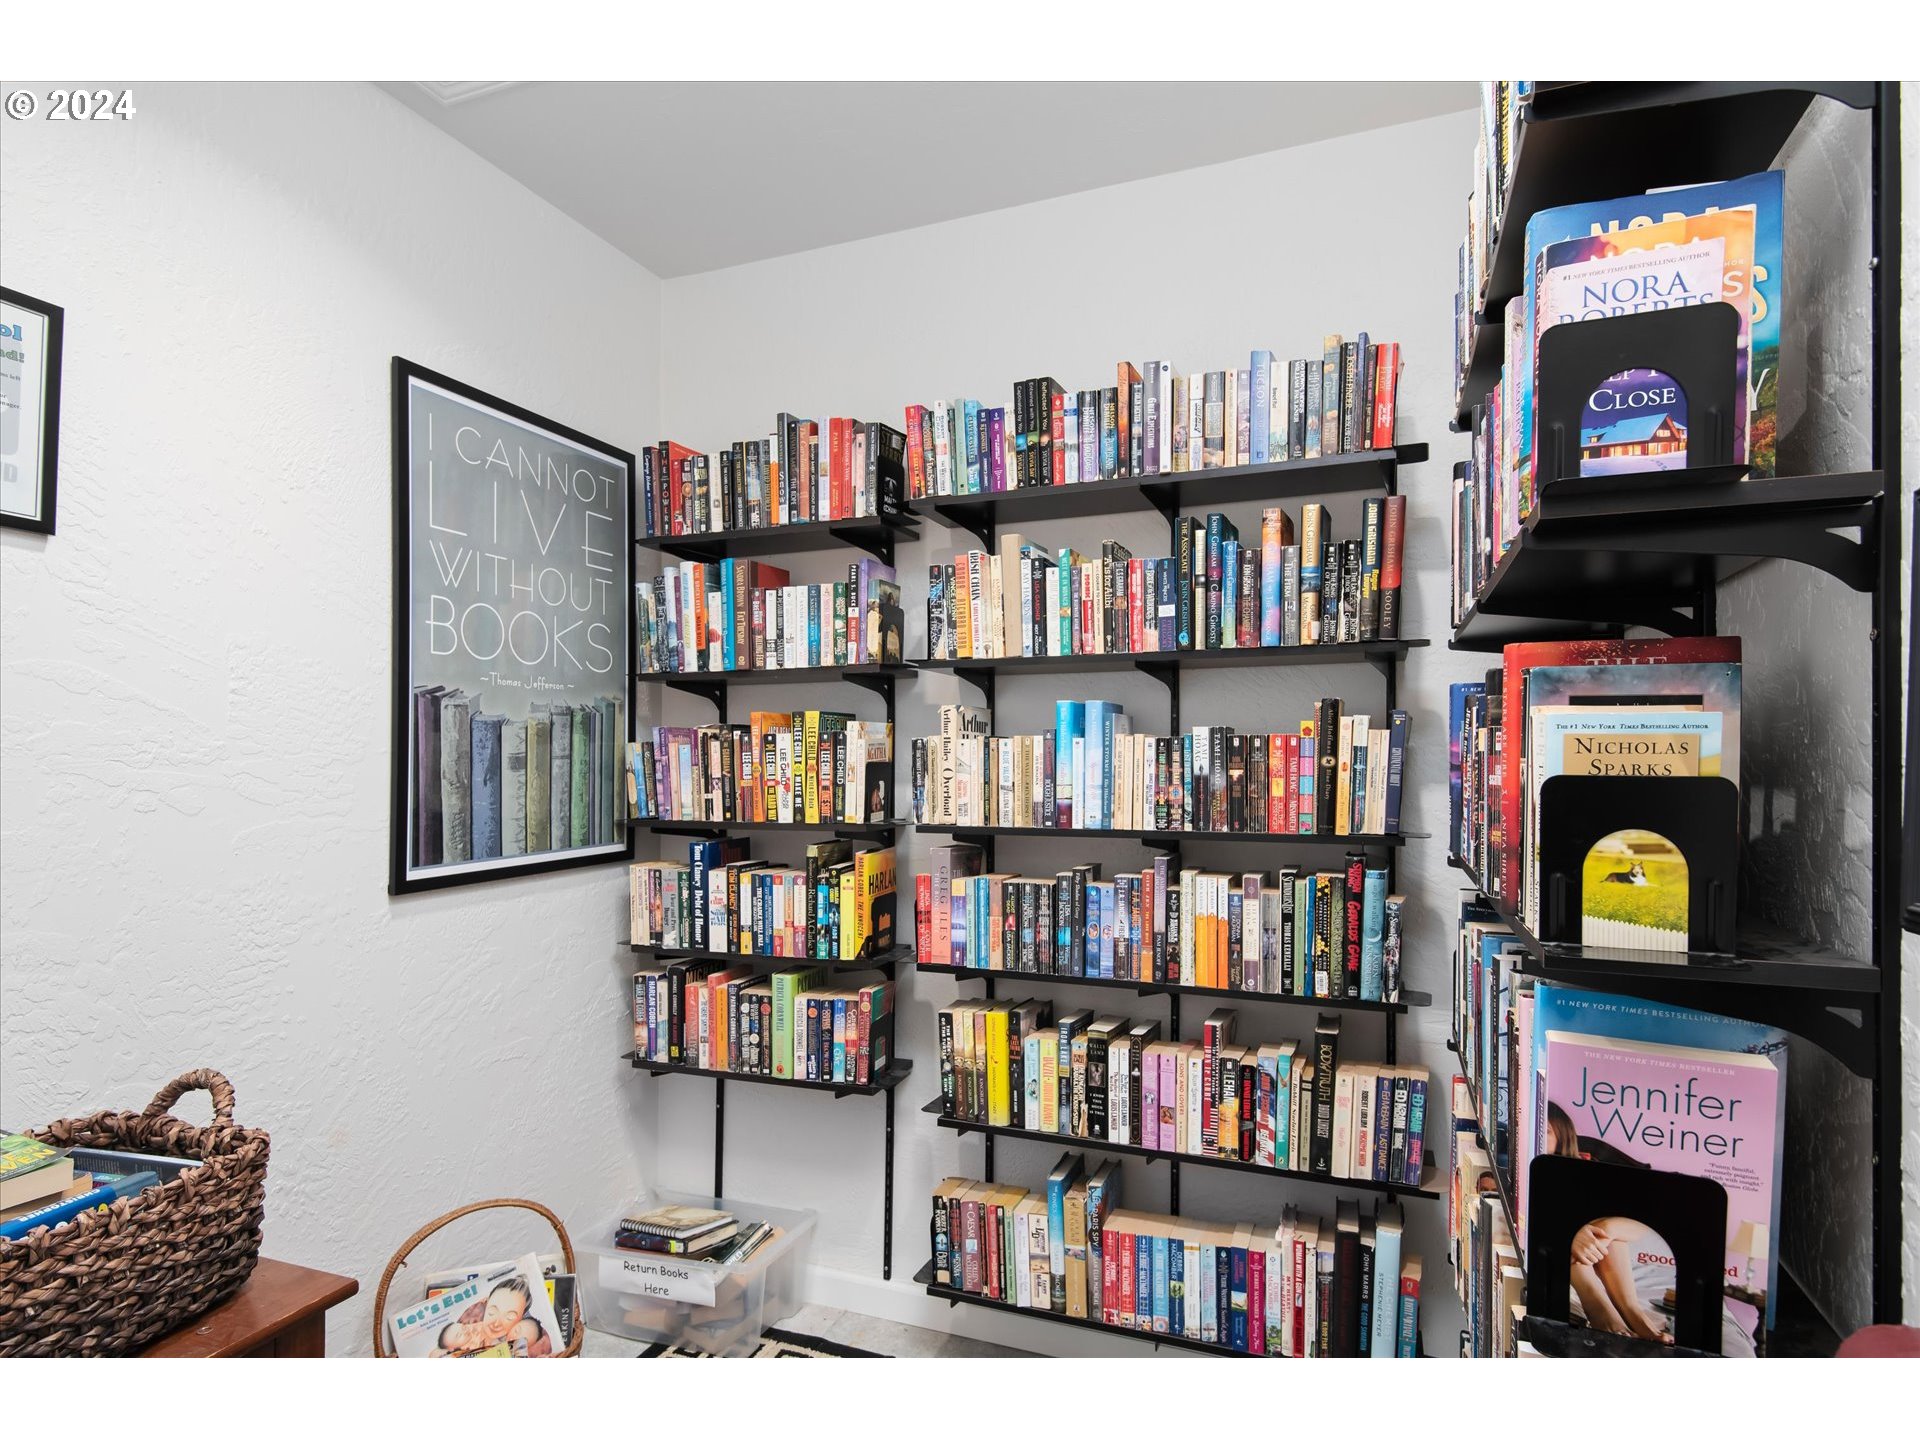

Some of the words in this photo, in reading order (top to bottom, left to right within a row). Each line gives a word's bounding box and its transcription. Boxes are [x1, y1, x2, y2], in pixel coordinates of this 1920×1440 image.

[1573, 272, 1587, 280] NEW
[1588, 269, 1604, 277] YORK
[1605, 265, 1627, 275] TIMES
[1628, 257, 1677, 272] BESTSELLING
[1677, 251, 1711, 263] AUTHOR
[1583, 270, 1690, 308] NORA
[1148, 398, 1156, 414] GREAT
[1588, 387, 1677, 412] CLOSE
[1147, 416, 1156, 448] EXPECTATIONS
[429, 412, 434, 452] I
[455, 425, 615, 505] CANNOT
[428, 459, 614, 573] LIVE
[1369, 503, 1378, 525] JOHN
[1367, 526, 1376, 565] GRISHAM
[1387, 531, 1396, 572] GRISHAM
[736, 566, 745, 585] SANDRA
[970, 552, 979, 574] IRISH
[428, 538, 614, 617] WITHOUT
[971, 577, 980, 601] CHAIN
[1363, 574, 1371, 599] Lawyer
[1371, 569, 1379, 591] Rogue
[736, 586, 744, 607] BROWN
[1210, 584, 1218, 613] CAMINO
[424, 594, 614, 675] BOOKS
[737, 622, 745, 644] TUESDAY
[523, 677, 564, 692] Jefferson
[943, 709, 951, 736] Arthur
[959, 712, 989, 735] Arthur
[942, 737, 951, 761] Hailey
[1575, 737, 1690, 756] NICHOLAS
[1587, 757, 1673, 777] SPARKS
[795, 797, 801, 807] ME
[693, 862, 703, 887] Clancy
[940, 866, 948, 904] GREG
[1353, 863, 1361, 893] STEPHEN
[695, 890, 703, 906] Debt
[695, 907, 703, 916] of
[695, 918, 704, 942] Honor
[940, 912, 948, 941] ILES
[1348, 944, 1359, 972] GAME
[1364, 944, 1372, 985] KINGSBURY
[776, 978, 784, 1001] PATRICIA
[1568, 1000, 1589, 1009] NEW
[1592, 1002, 1617, 1012] YORK
[1620, 1006, 1649, 1016] TIMES
[1651, 1009, 1720, 1024] BESTSELLING
[1722, 1017, 1767, 1029] AUTHOR
[1060, 1046, 1068, 1063] LAKE
[1583, 1051, 1600, 1059] THE
[1602, 1053, 1621, 1062] NEW
[1622, 1056, 1648, 1065] YORK
[1649, 1059, 1677, 1069] TIMES
[1678, 1063, 1736, 1076] BESTSELLER
[1382, 1091, 1391, 1101] Ed
[1572, 1066, 1741, 1122] Jennifer
[1380, 1134, 1388, 1149] LAST
[1590, 1105, 1744, 1159] Weiner
[1378, 1150, 1387, 1170] DANCE
[967, 1211, 975, 1239] CAESAR
[623, 1260, 658, 1276] Return
[660, 1265, 689, 1280] Books
[643, 1283, 670, 1297] Here
[1386, 1273, 1394, 1293] THE
[442, 1284, 478, 1309] Eat!
[1384, 1296, 1393, 1341] CHEMIST
